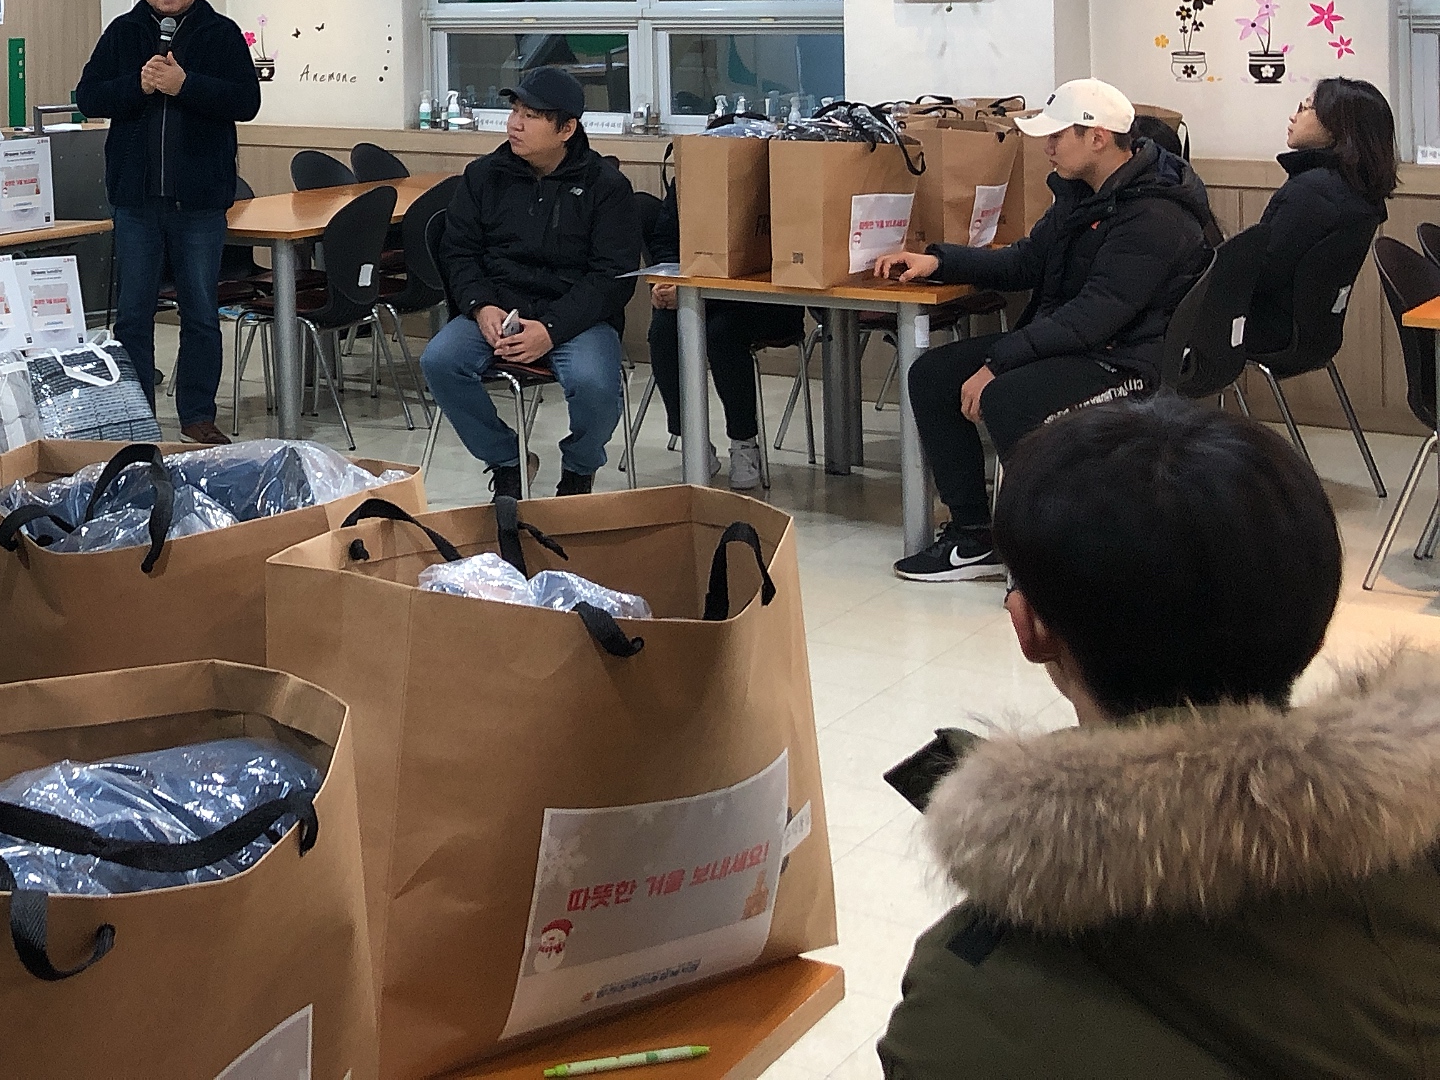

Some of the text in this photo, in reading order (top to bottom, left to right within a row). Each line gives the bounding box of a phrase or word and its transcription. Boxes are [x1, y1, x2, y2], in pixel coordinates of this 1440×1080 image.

[299, 64, 357, 83] Anemone
[566, 879, 637, 913] 따뜻한
[689, 840, 769, 886] 보내세요!
